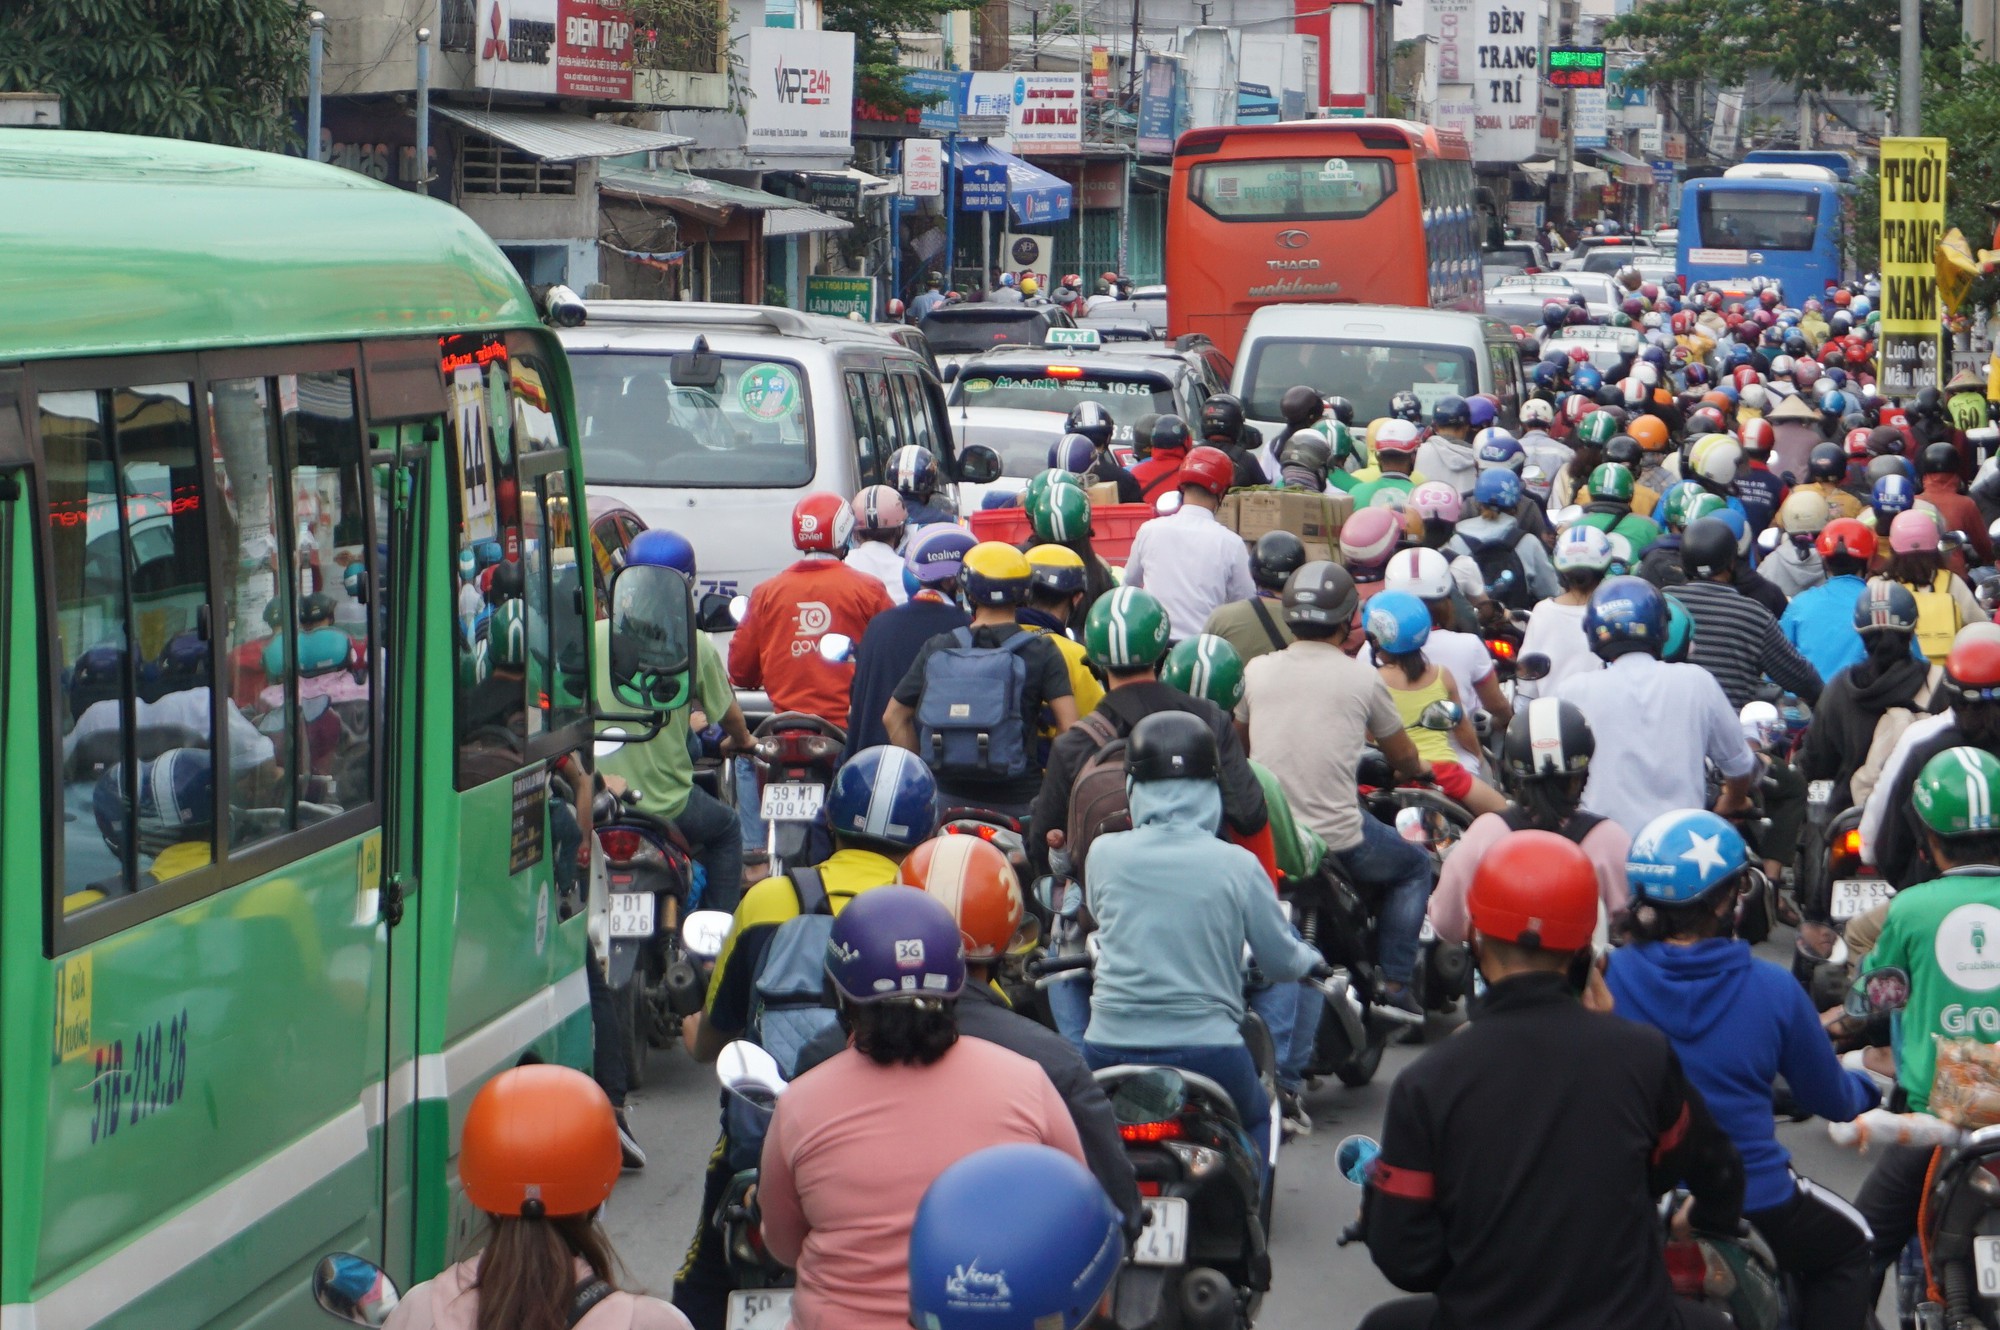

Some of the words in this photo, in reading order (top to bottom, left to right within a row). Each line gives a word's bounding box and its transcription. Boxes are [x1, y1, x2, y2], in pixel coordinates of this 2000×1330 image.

[1488, 5, 1525, 34] ĐÈN
[566, 12, 599, 54] ĐIỆN
[601, 15, 629, 55] TẬP
[1478, 46, 1537, 69] TRANG
[775, 67, 808, 104] VAPE
[809, 69, 831, 94] 24h
[1489, 74, 1522, 104] TRÍ
[1509, 115, 1537, 130] LIGHT
[1328, 160, 1343, 171] 04
[1883, 145, 1942, 204] THỜI
[911, 181, 938, 190] 24H
[1266, 259, 1320, 270] THACO
[1887, 276, 1937, 320] NAM
[1057, 331, 1088, 342] TAXI
[1886, 341, 1915, 359] Luôn
[1918, 341, 1936, 359] Có
[1884, 364, 1911, 386] Mẫu
[1913, 367, 1936, 387] Mới
[1107, 382, 1150, 397] 1055
[1958, 406, 1980, 431] 60
[798, 530, 824, 542] goviet
[927, 549, 961, 562] tealive
[899, 943, 920, 958] 3G
